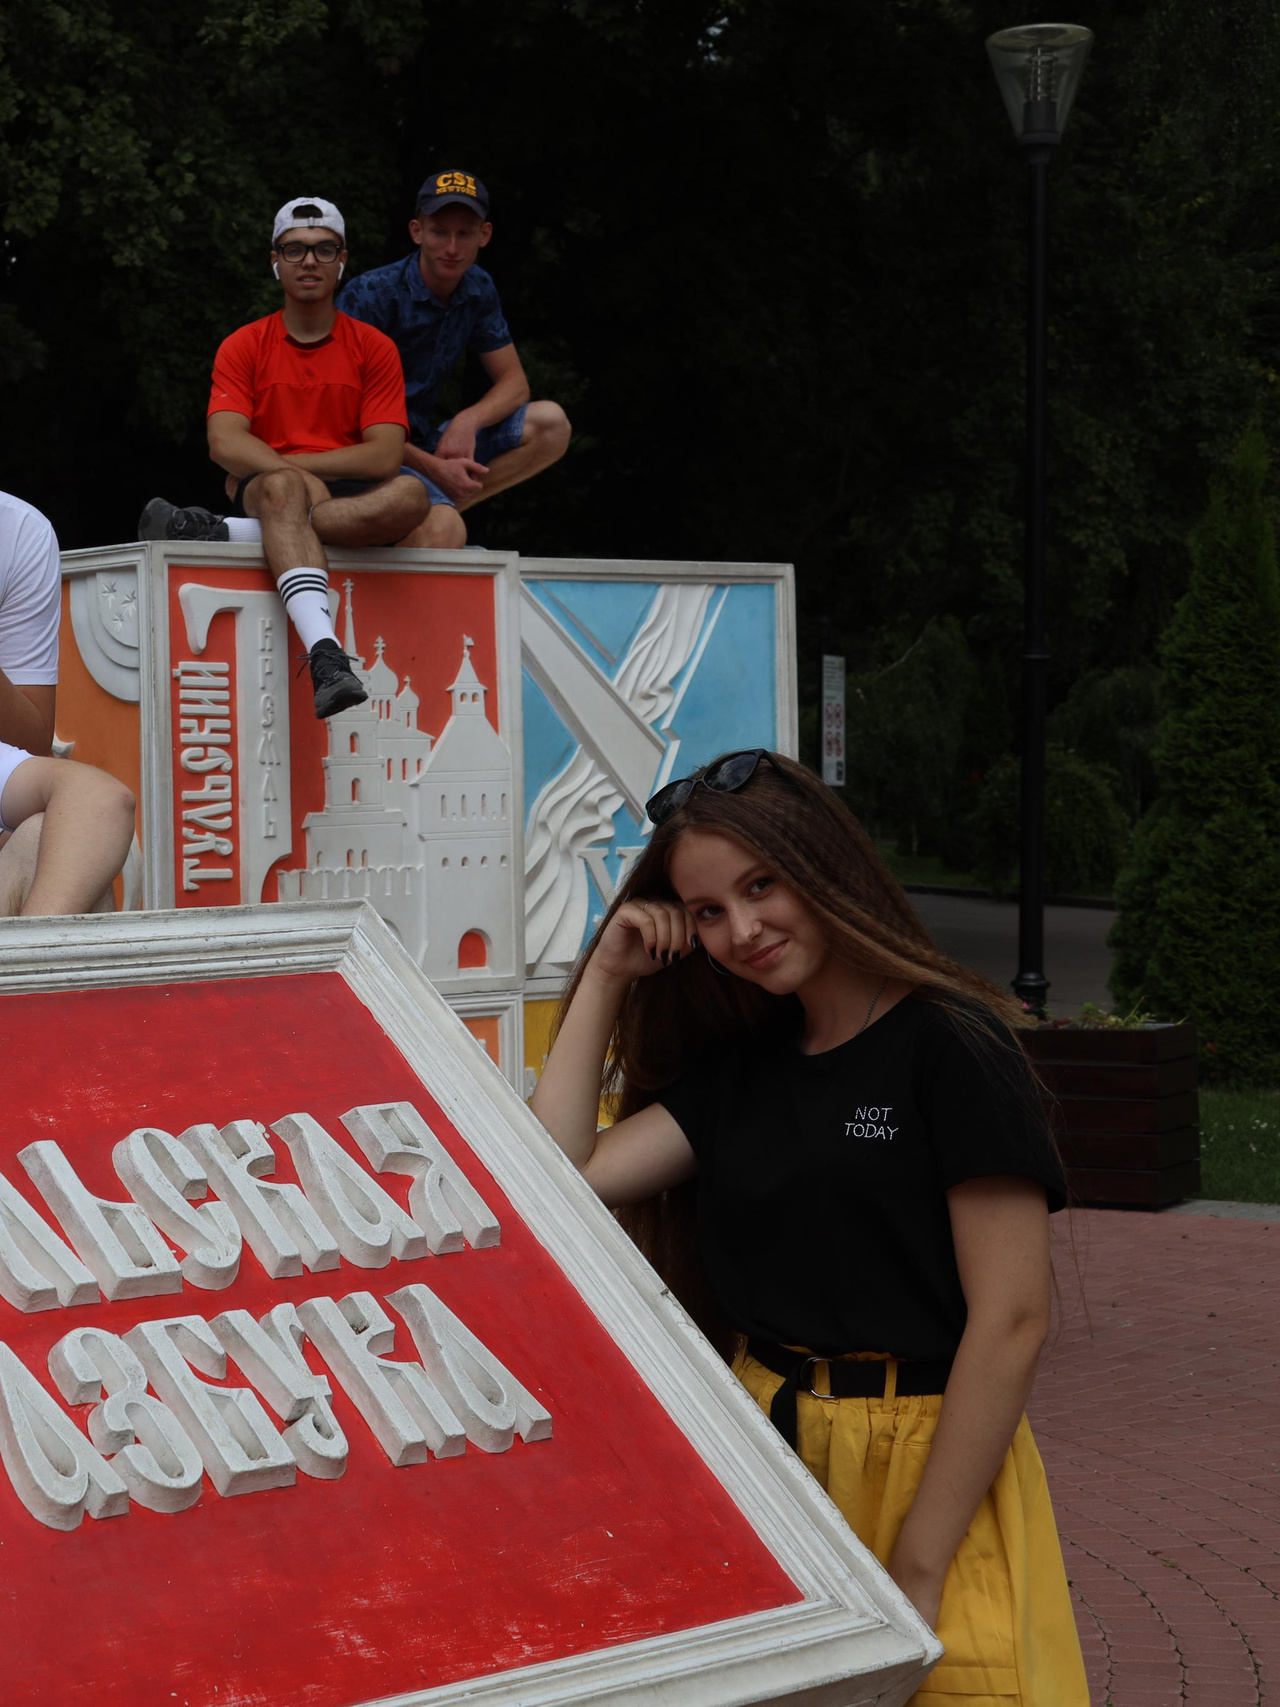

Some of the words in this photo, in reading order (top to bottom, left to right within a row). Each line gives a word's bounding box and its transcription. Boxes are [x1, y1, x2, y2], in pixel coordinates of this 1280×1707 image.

[436, 171, 477, 190] CSI
[172, 661, 234, 891] ТУЛЬСКИЙ
[855, 1106, 893, 1122] NOT
[844, 1122, 899, 1141] TODAY
